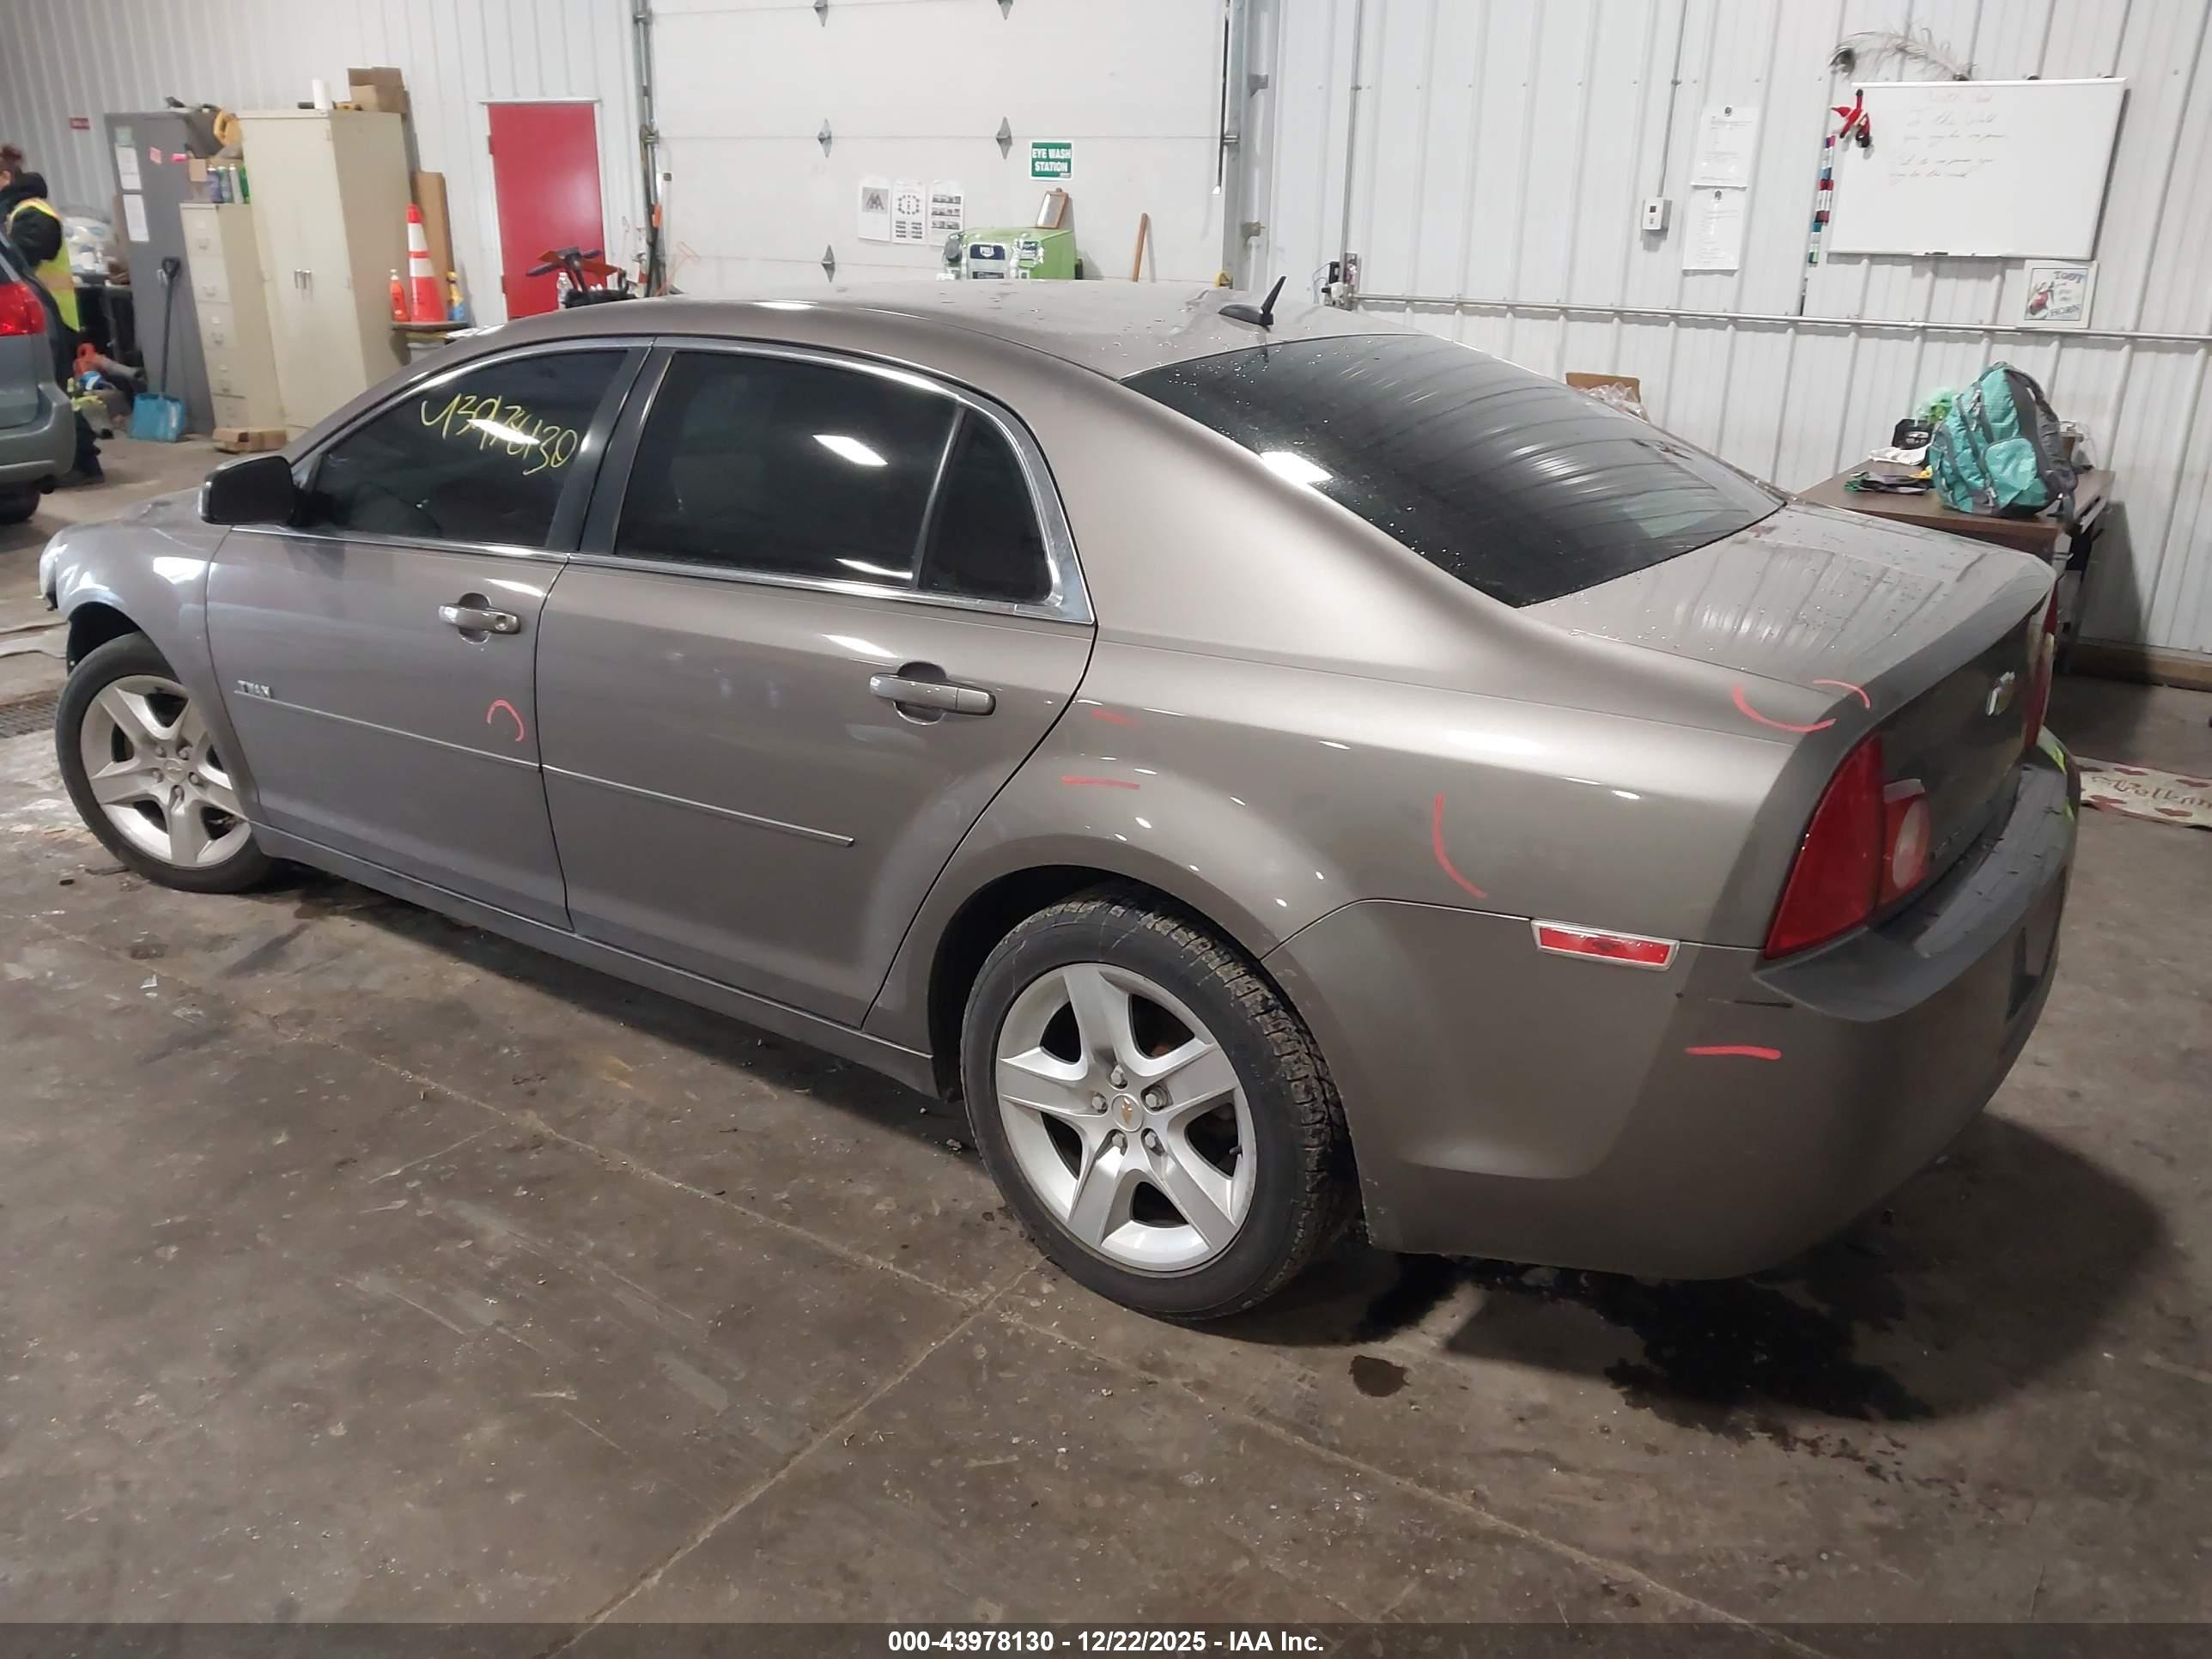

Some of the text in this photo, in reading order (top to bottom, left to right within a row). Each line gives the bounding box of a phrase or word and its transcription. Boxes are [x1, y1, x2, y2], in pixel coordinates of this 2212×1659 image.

[1032, 148, 1072, 160] EYE WASH
[1035, 161, 1068, 173] STATION
[2053, 270, 2089, 284] TOOT
